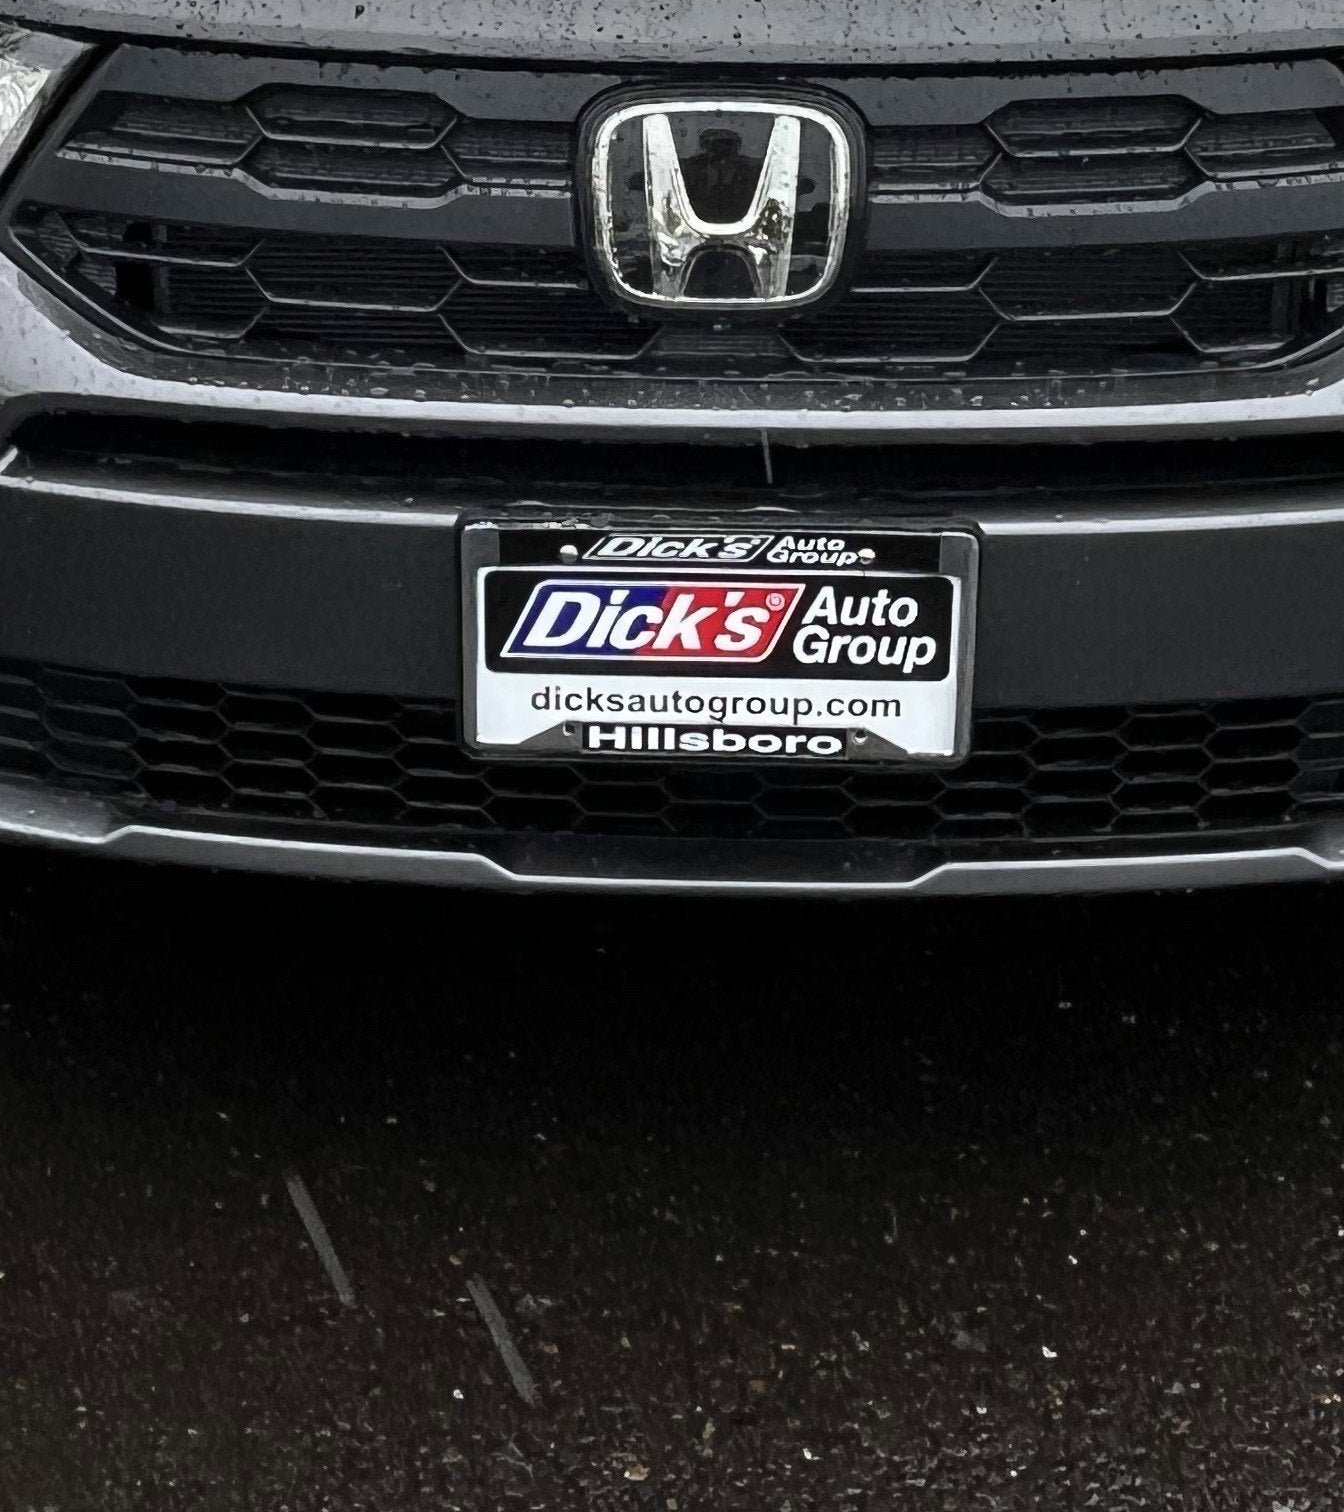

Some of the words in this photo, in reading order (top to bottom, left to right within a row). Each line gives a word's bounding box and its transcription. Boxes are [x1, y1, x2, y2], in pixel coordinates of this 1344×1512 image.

[766, 548, 859, 566] Group
[777, 536, 846, 551] Auto
[801, 586, 918, 628] Auto
[792, 626, 937, 674] Group
[531, 686, 902, 724] dicksautogroup.com
[588, 726, 843, 755] Hillsboro
